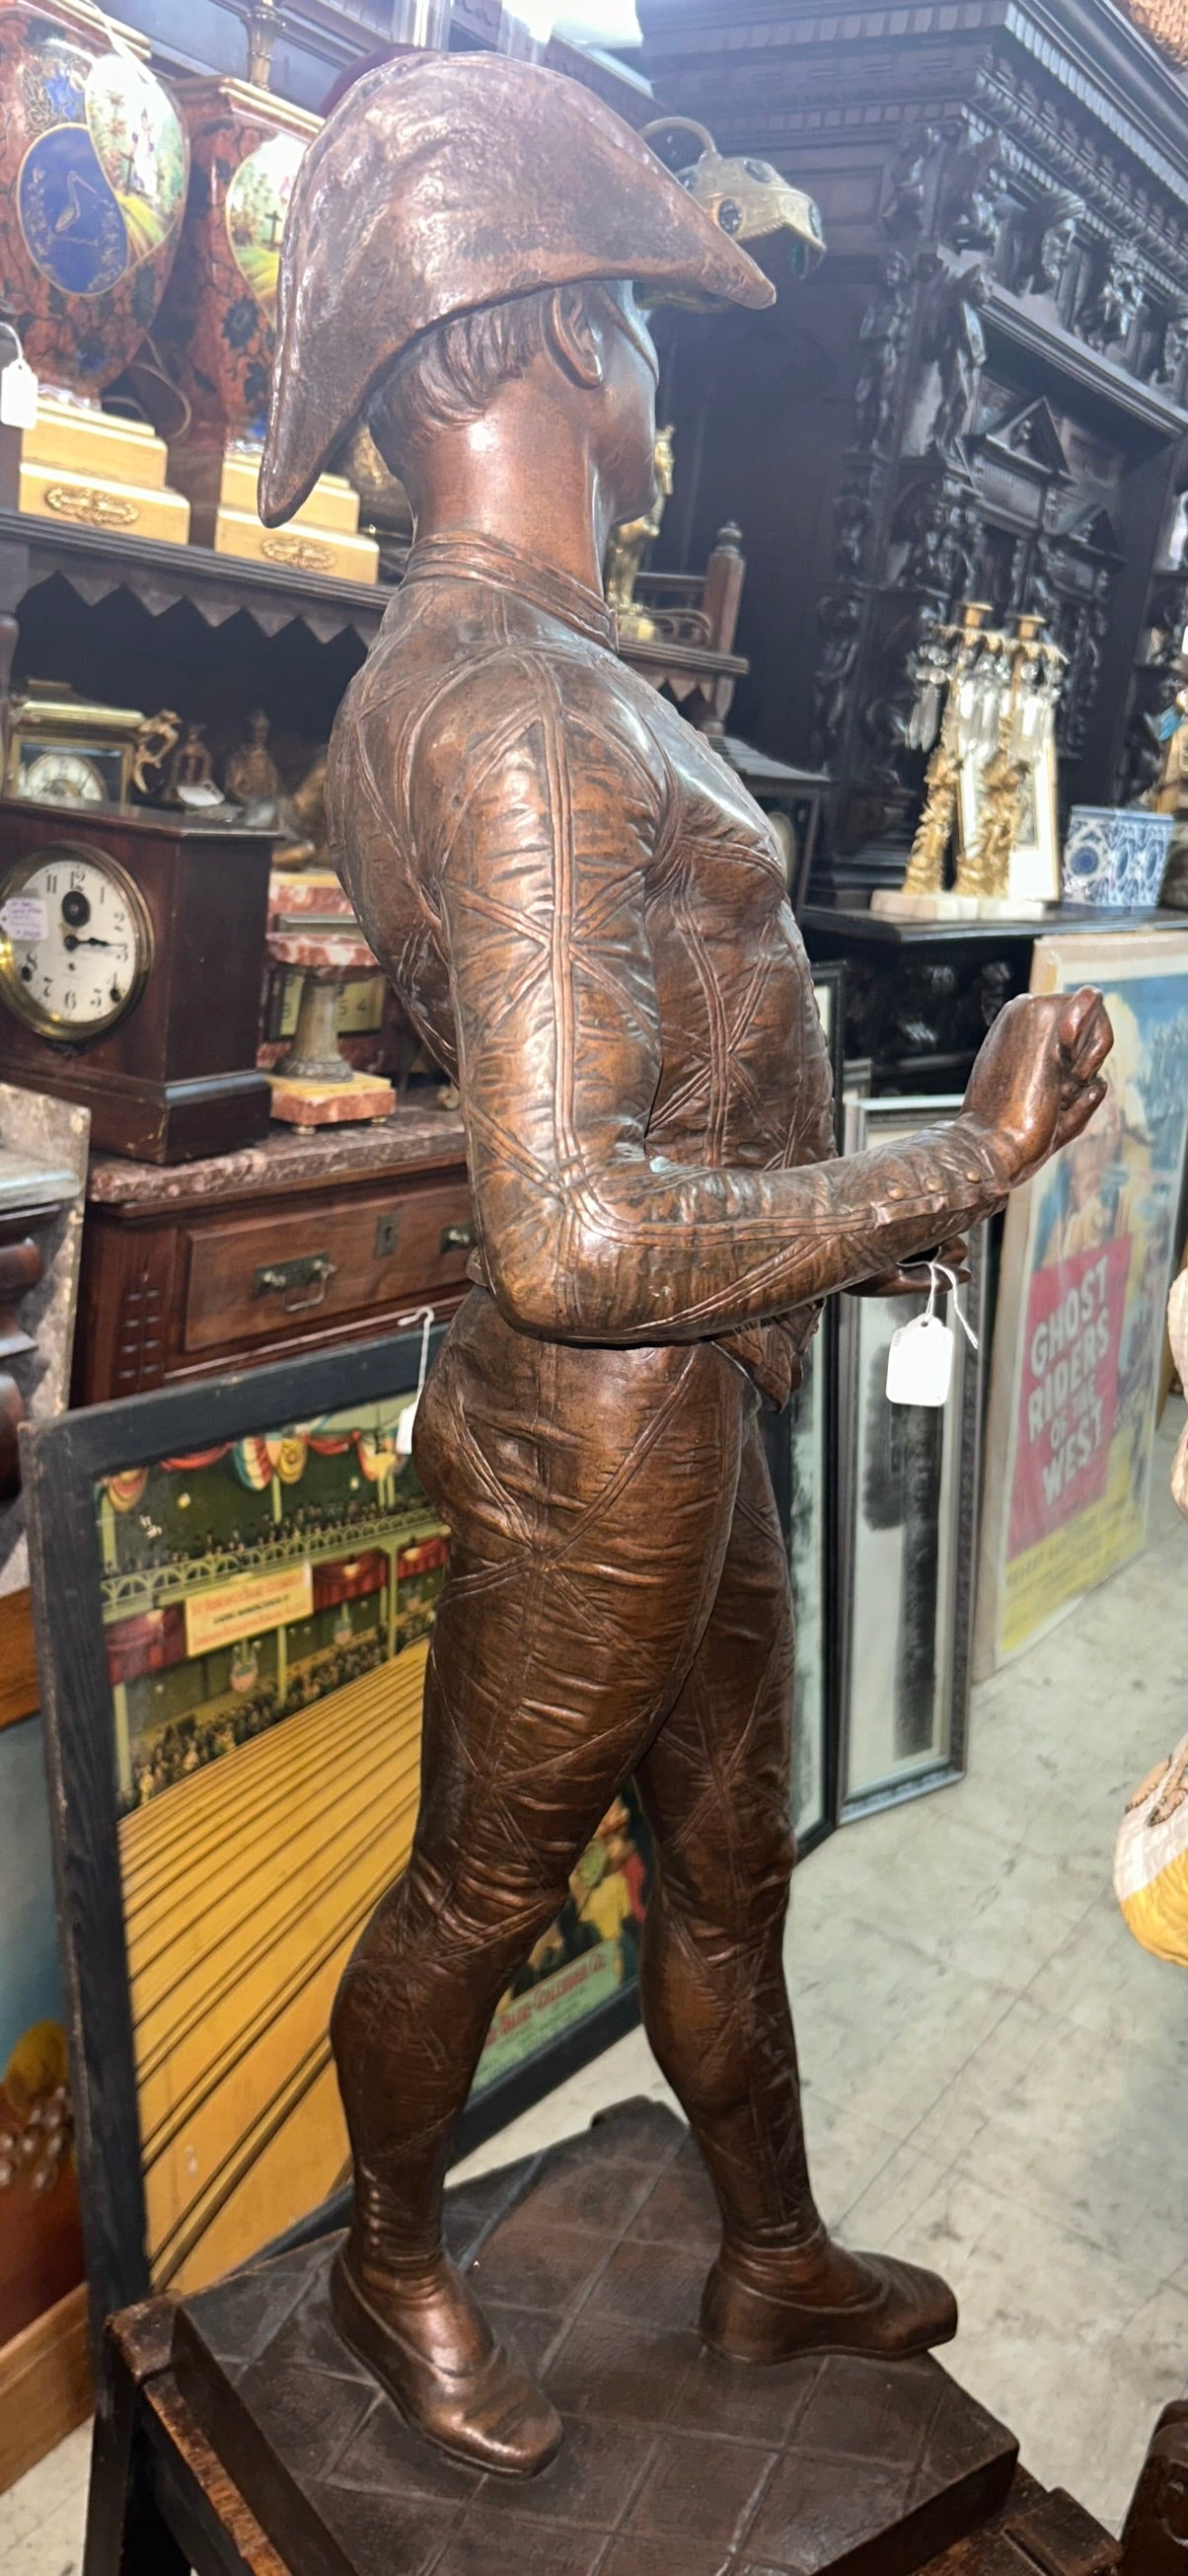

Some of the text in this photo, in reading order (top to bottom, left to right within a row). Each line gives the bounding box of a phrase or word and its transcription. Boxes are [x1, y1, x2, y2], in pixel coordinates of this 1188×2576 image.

[47, 874, 58, 895] 11
[70, 871, 86, 892] 12
[113, 910, 125, 933] 2
[42, 976, 54, 998] 7
[64, 989, 77, 1011] 6
[90, 988, 103, 1009] 5
[1030, 1252, 1109, 1379] GHOST
[1027, 1307, 1109, 1443] RIDERS
[1050, 1410, 1067, 1451] OF
[1042, 1398, 1102, 1506] WEST
